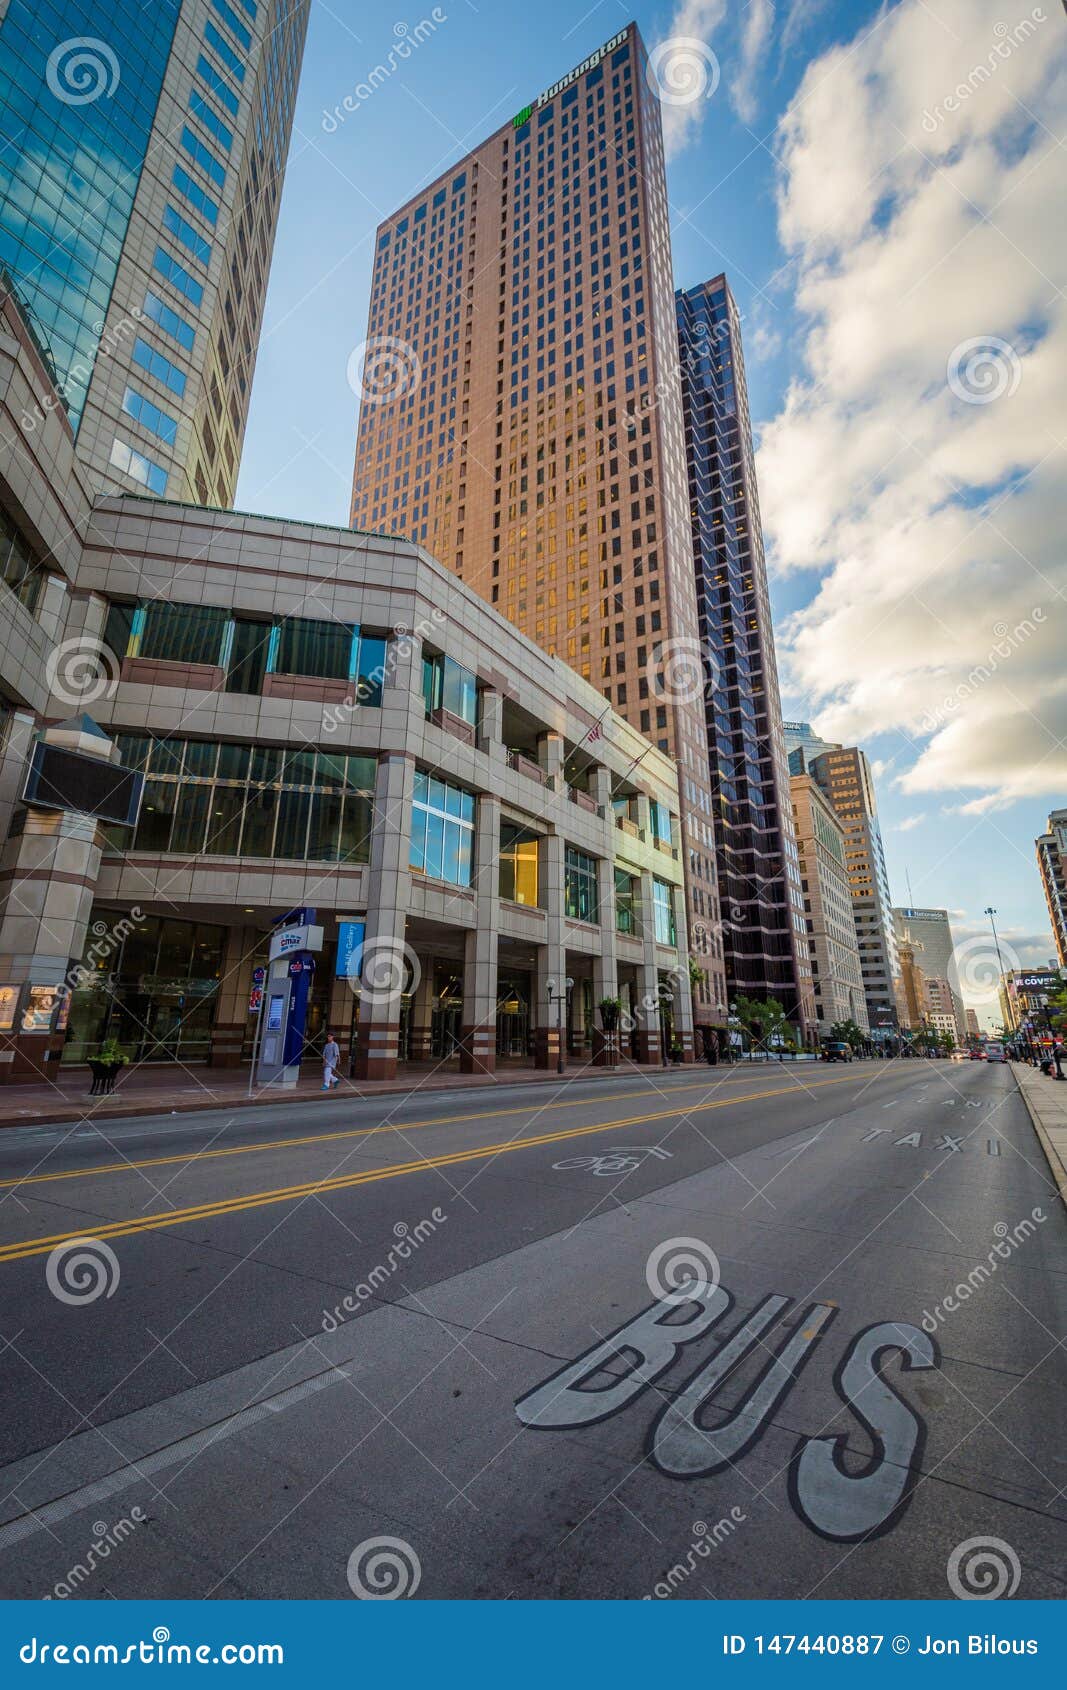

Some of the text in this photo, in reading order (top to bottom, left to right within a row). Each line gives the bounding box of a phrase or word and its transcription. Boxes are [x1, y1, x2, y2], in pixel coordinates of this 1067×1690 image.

[537, 29, 628, 109] Huntington
[861, 1127, 1000, 1156] TAXI
[514, 1279, 941, 1543] BUS
